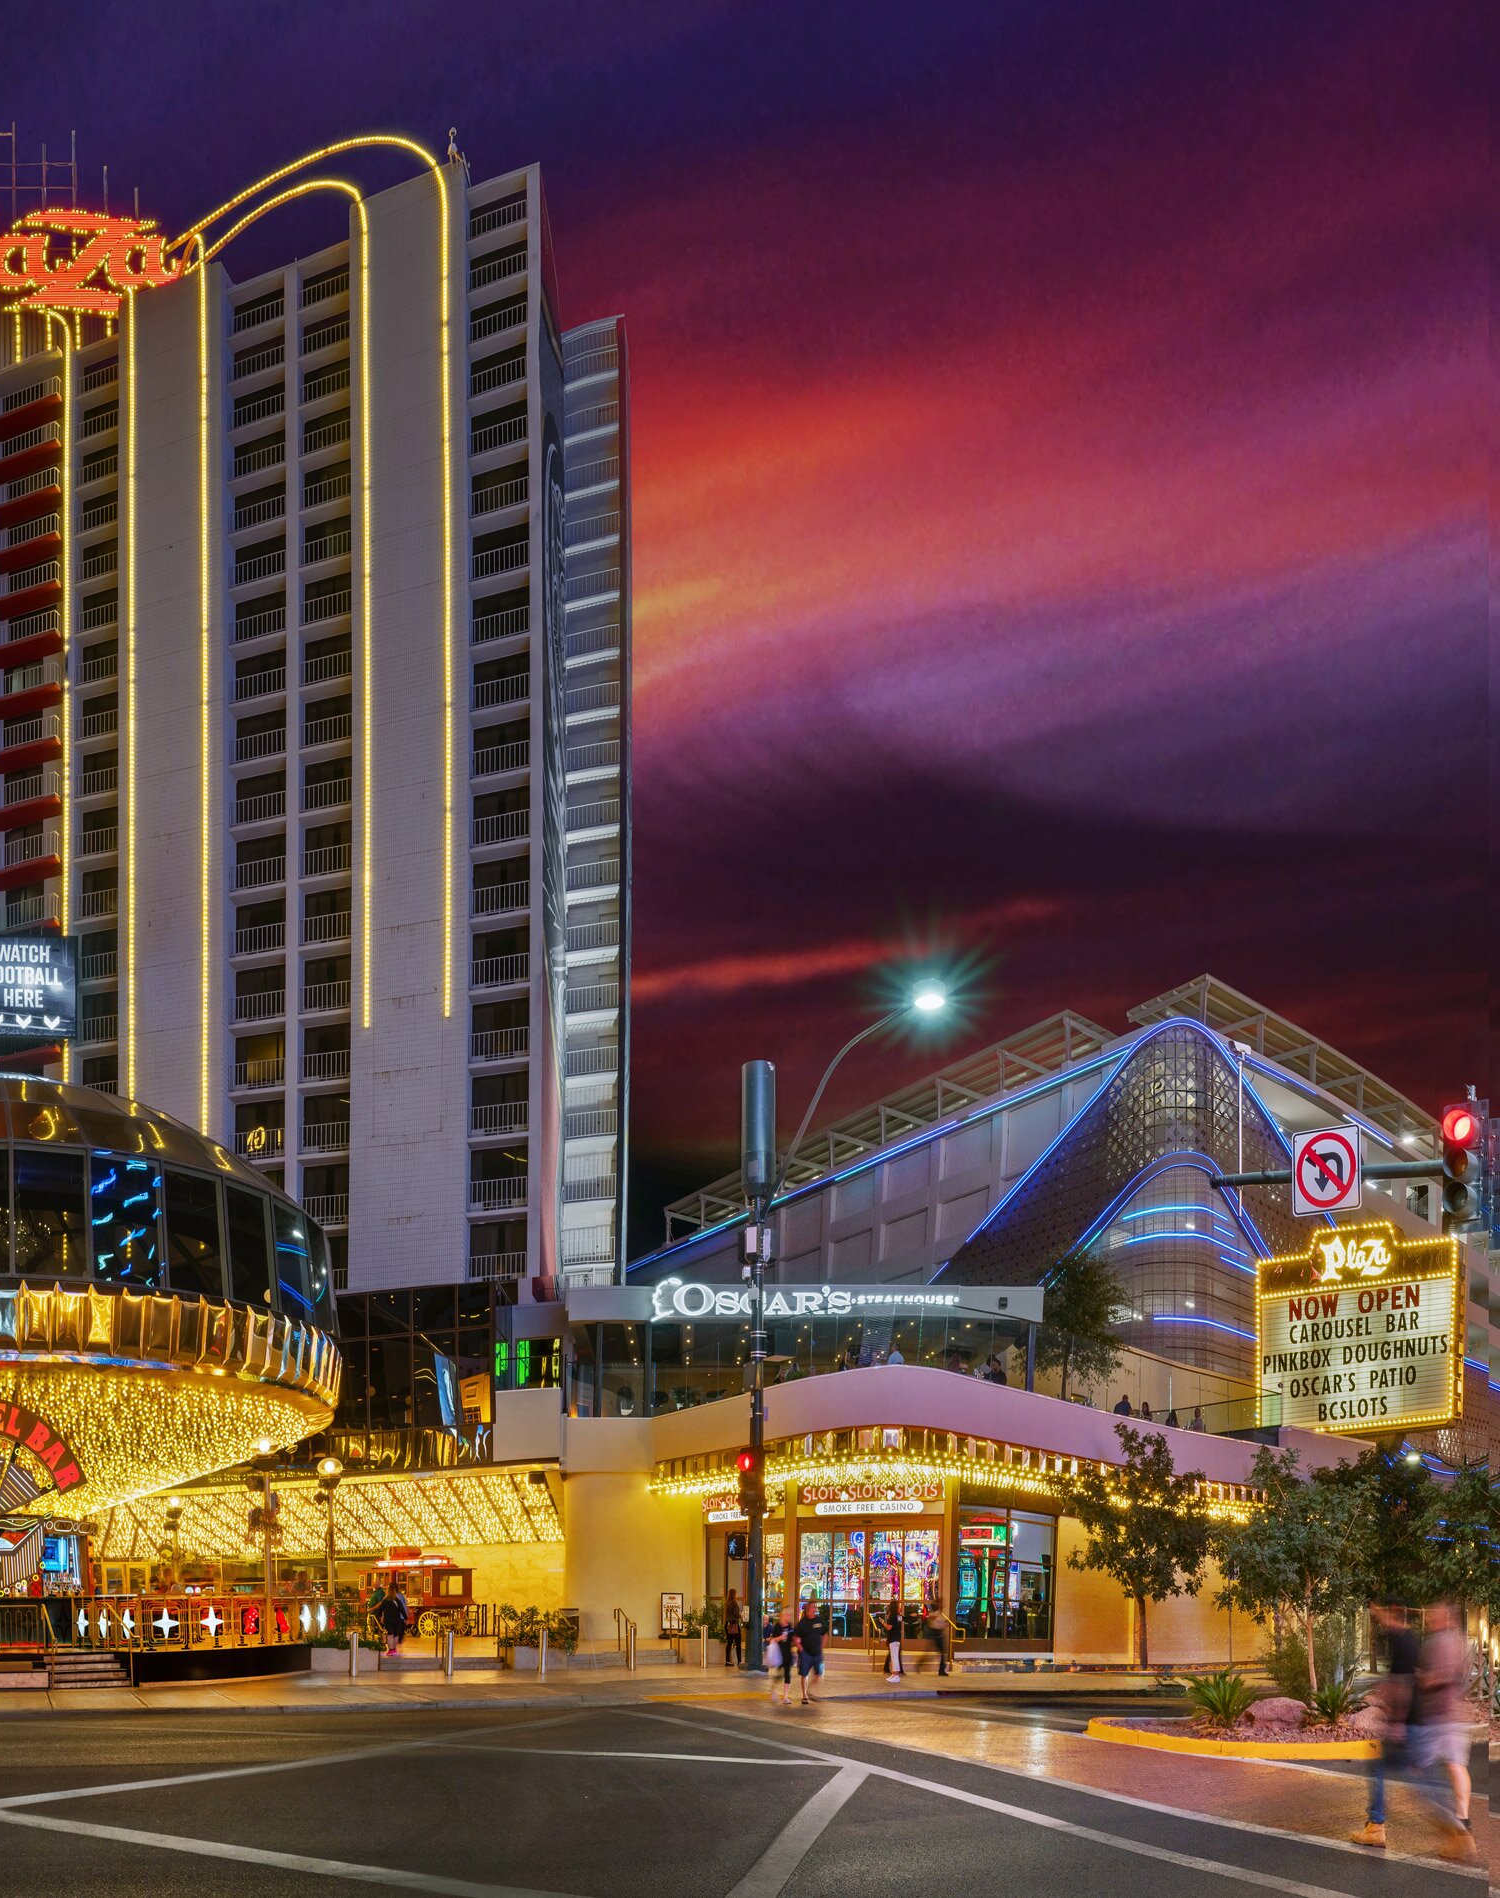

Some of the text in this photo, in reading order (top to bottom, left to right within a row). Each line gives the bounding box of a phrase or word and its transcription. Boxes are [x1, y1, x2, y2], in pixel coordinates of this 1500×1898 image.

[3, 988, 44, 1008] HERE
[1319, 1236, 1392, 1282] Plaza
[856, 1294, 954, 1306] STEAKHOUSE
[1288, 1284, 1421, 1322] NOW OPEN
[1289, 1311, 1420, 1344] CAROUSEL BAR
[1263, 1334, 1448, 1374] PINKBOX DOUGHNUTS
[1290, 1365, 1417, 1399] OSCAR'S PATIO
[1318, 1396, 1388, 1421] BCSLOTS
[24, 1421, 81, 1491] BAR
[702, 1497, 722, 1512] SLOTS
[803, 1483, 938, 1503] SLOTS SLOTS SLOTS
[712, 1512, 728, 1520] SMOKE
[823, 1502, 914, 1513] SMOKE FREE CASINO
